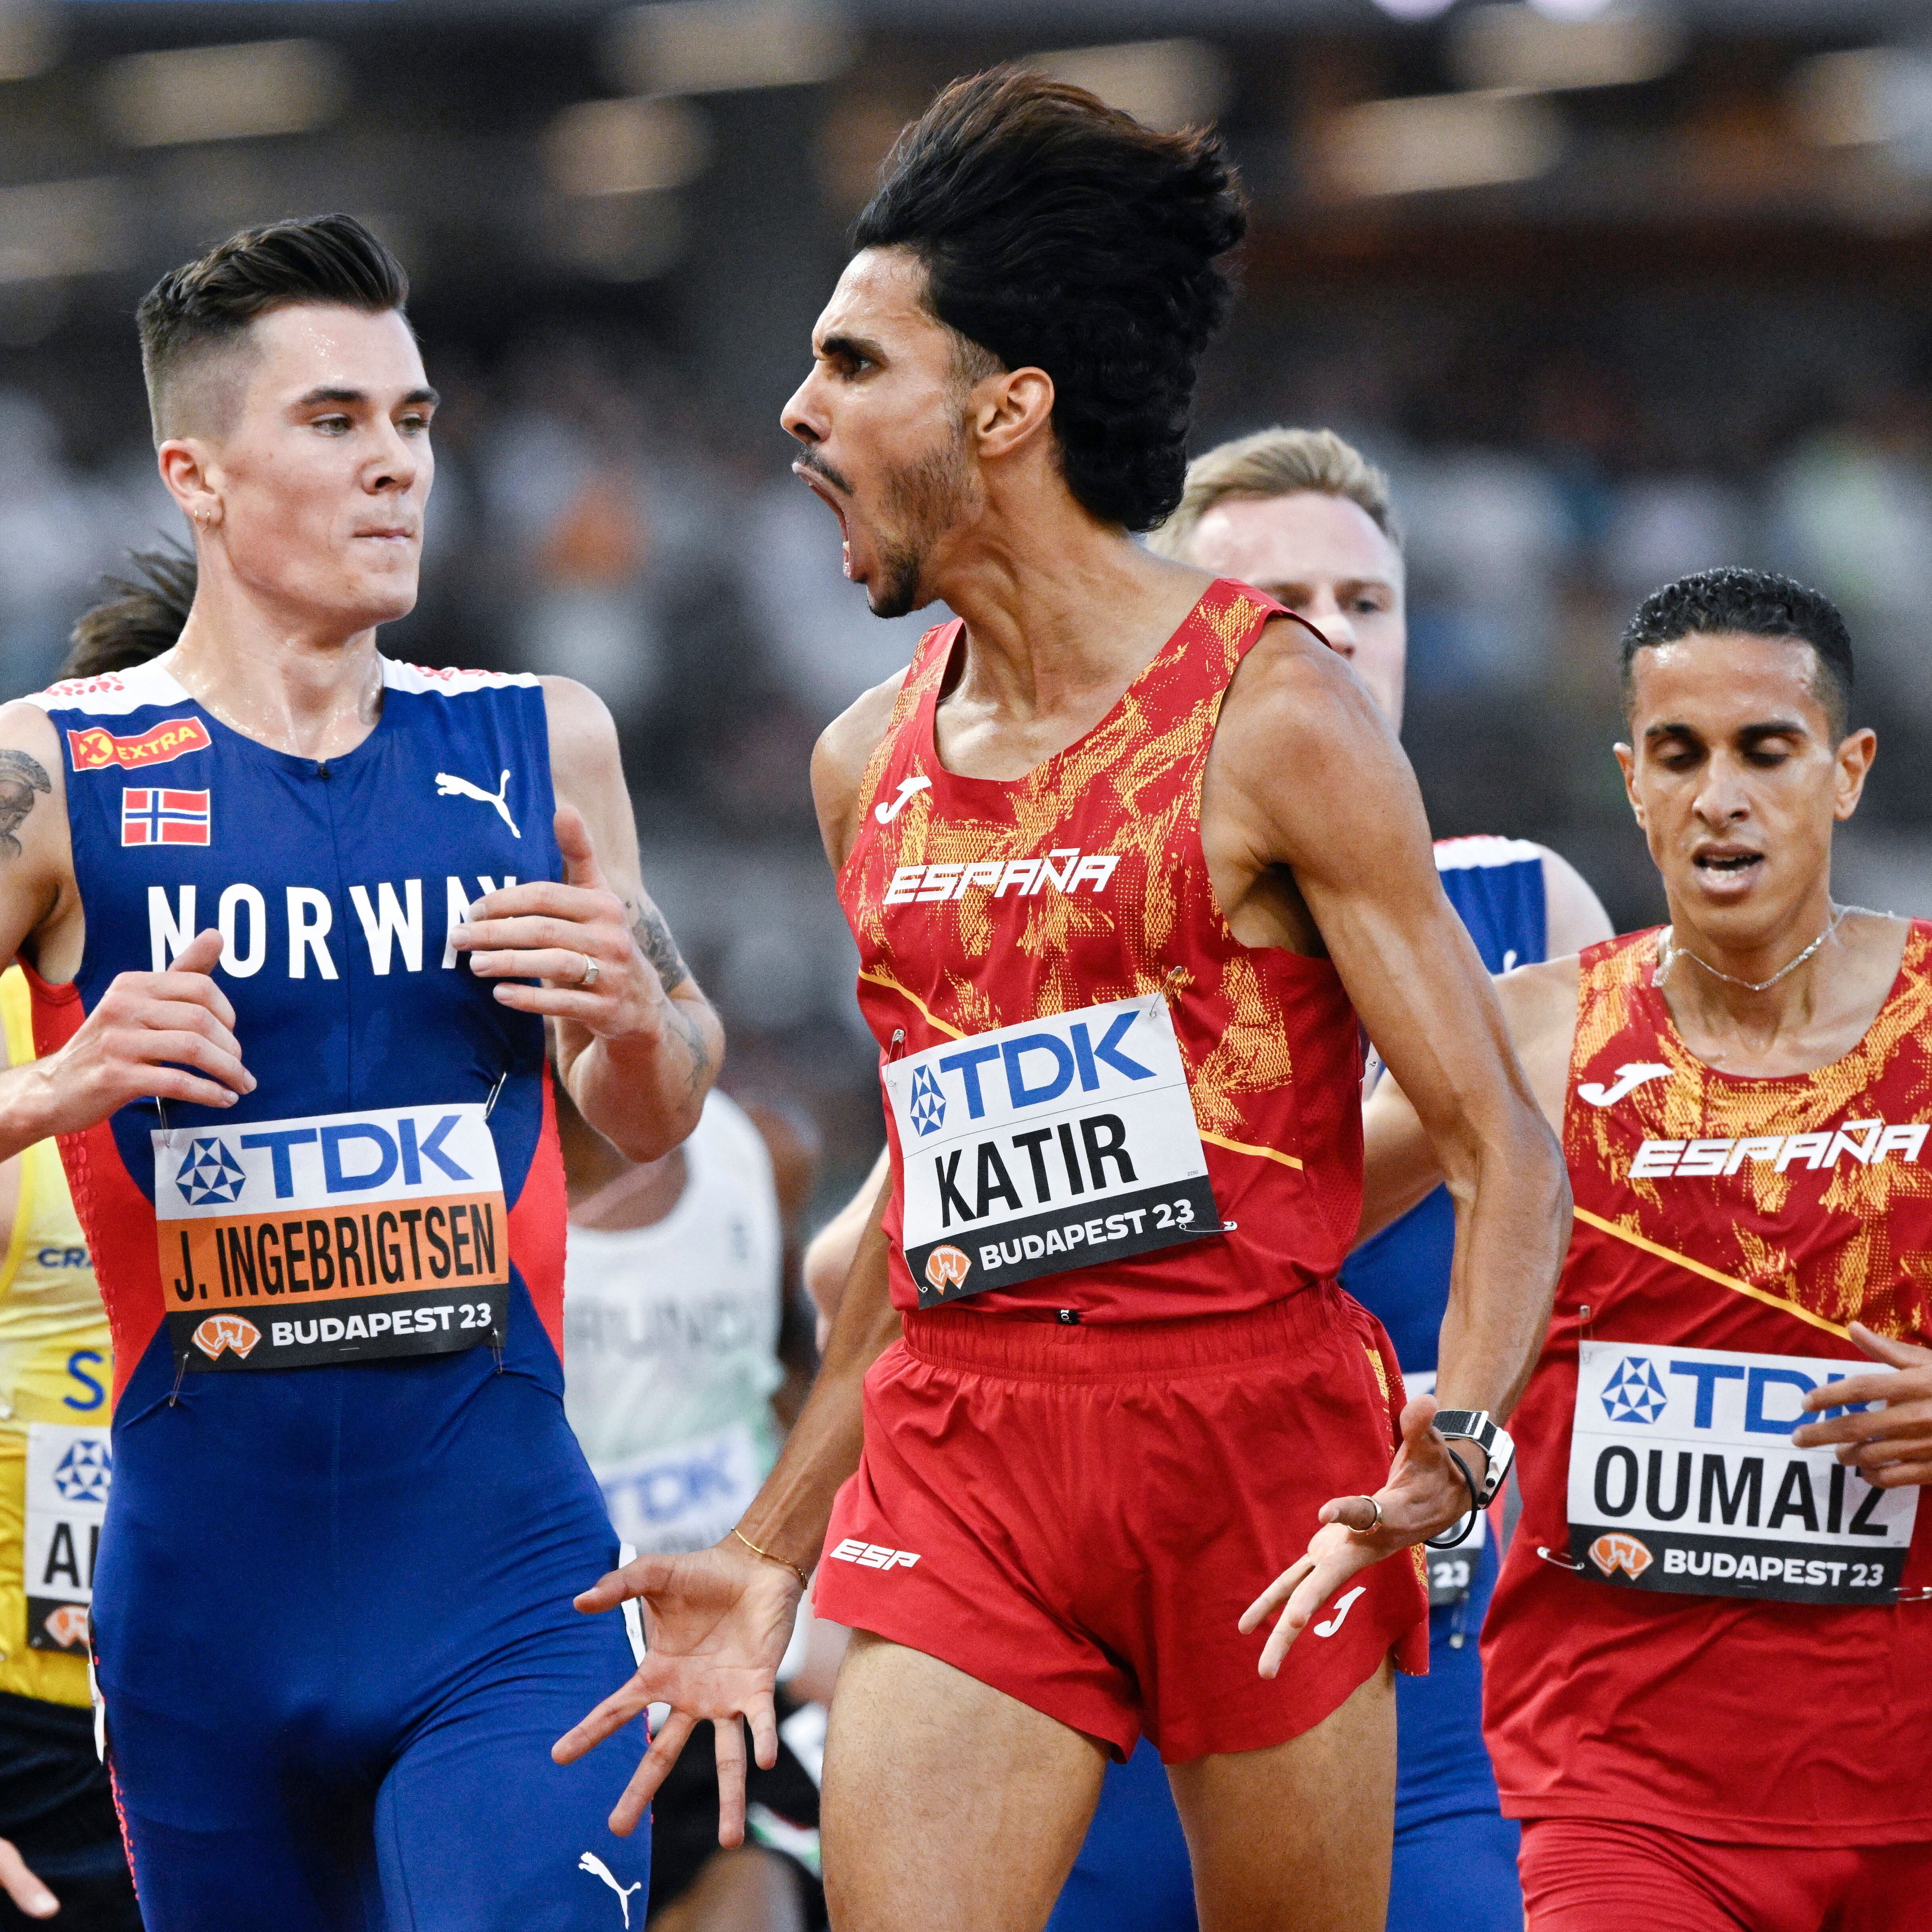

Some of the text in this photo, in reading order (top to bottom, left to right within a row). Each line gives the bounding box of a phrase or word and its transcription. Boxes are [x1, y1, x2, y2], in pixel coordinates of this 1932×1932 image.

[116, 726, 198, 760] EXTRA
[883, 848, 1121, 905] ESPAÑA
[148, 876, 516, 979] NORWA
[940, 1010, 1157, 1120] TDK
[240, 1115, 474, 1199] TDK
[935, 1114, 1139, 1228] KATIR
[1628, 1119, 1930, 1178] ESPAÑA
[175, 1203, 496, 1302] J. INGEBRIGTSEN
[979, 1199, 1195, 1270] BUDAPEST 23
[271, 1303, 492, 1346] BUDAPEST 23
[1594, 1445, 1888, 1536] OUMAIZ
[829, 1538, 921, 1570] ESP
[1664, 1548, 1884, 1586] BUDAPEST 23
